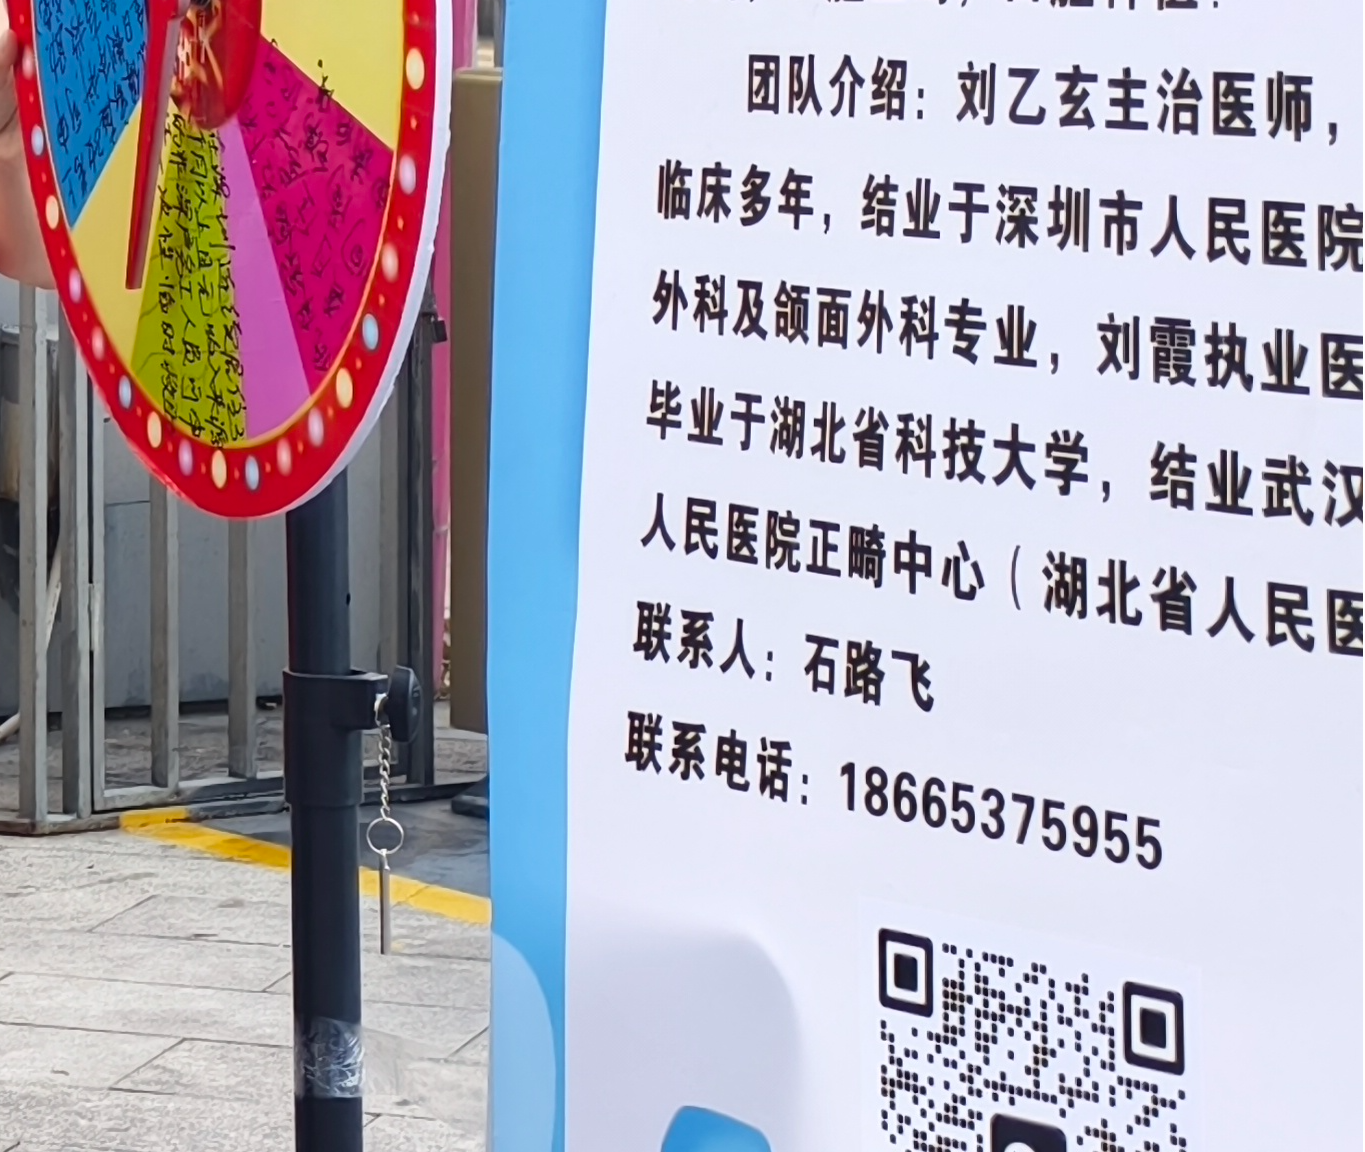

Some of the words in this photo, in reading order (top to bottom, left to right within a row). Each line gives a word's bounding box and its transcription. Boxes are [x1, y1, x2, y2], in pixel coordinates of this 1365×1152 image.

[633, 601, 934, 712] 联系人：石路飞
